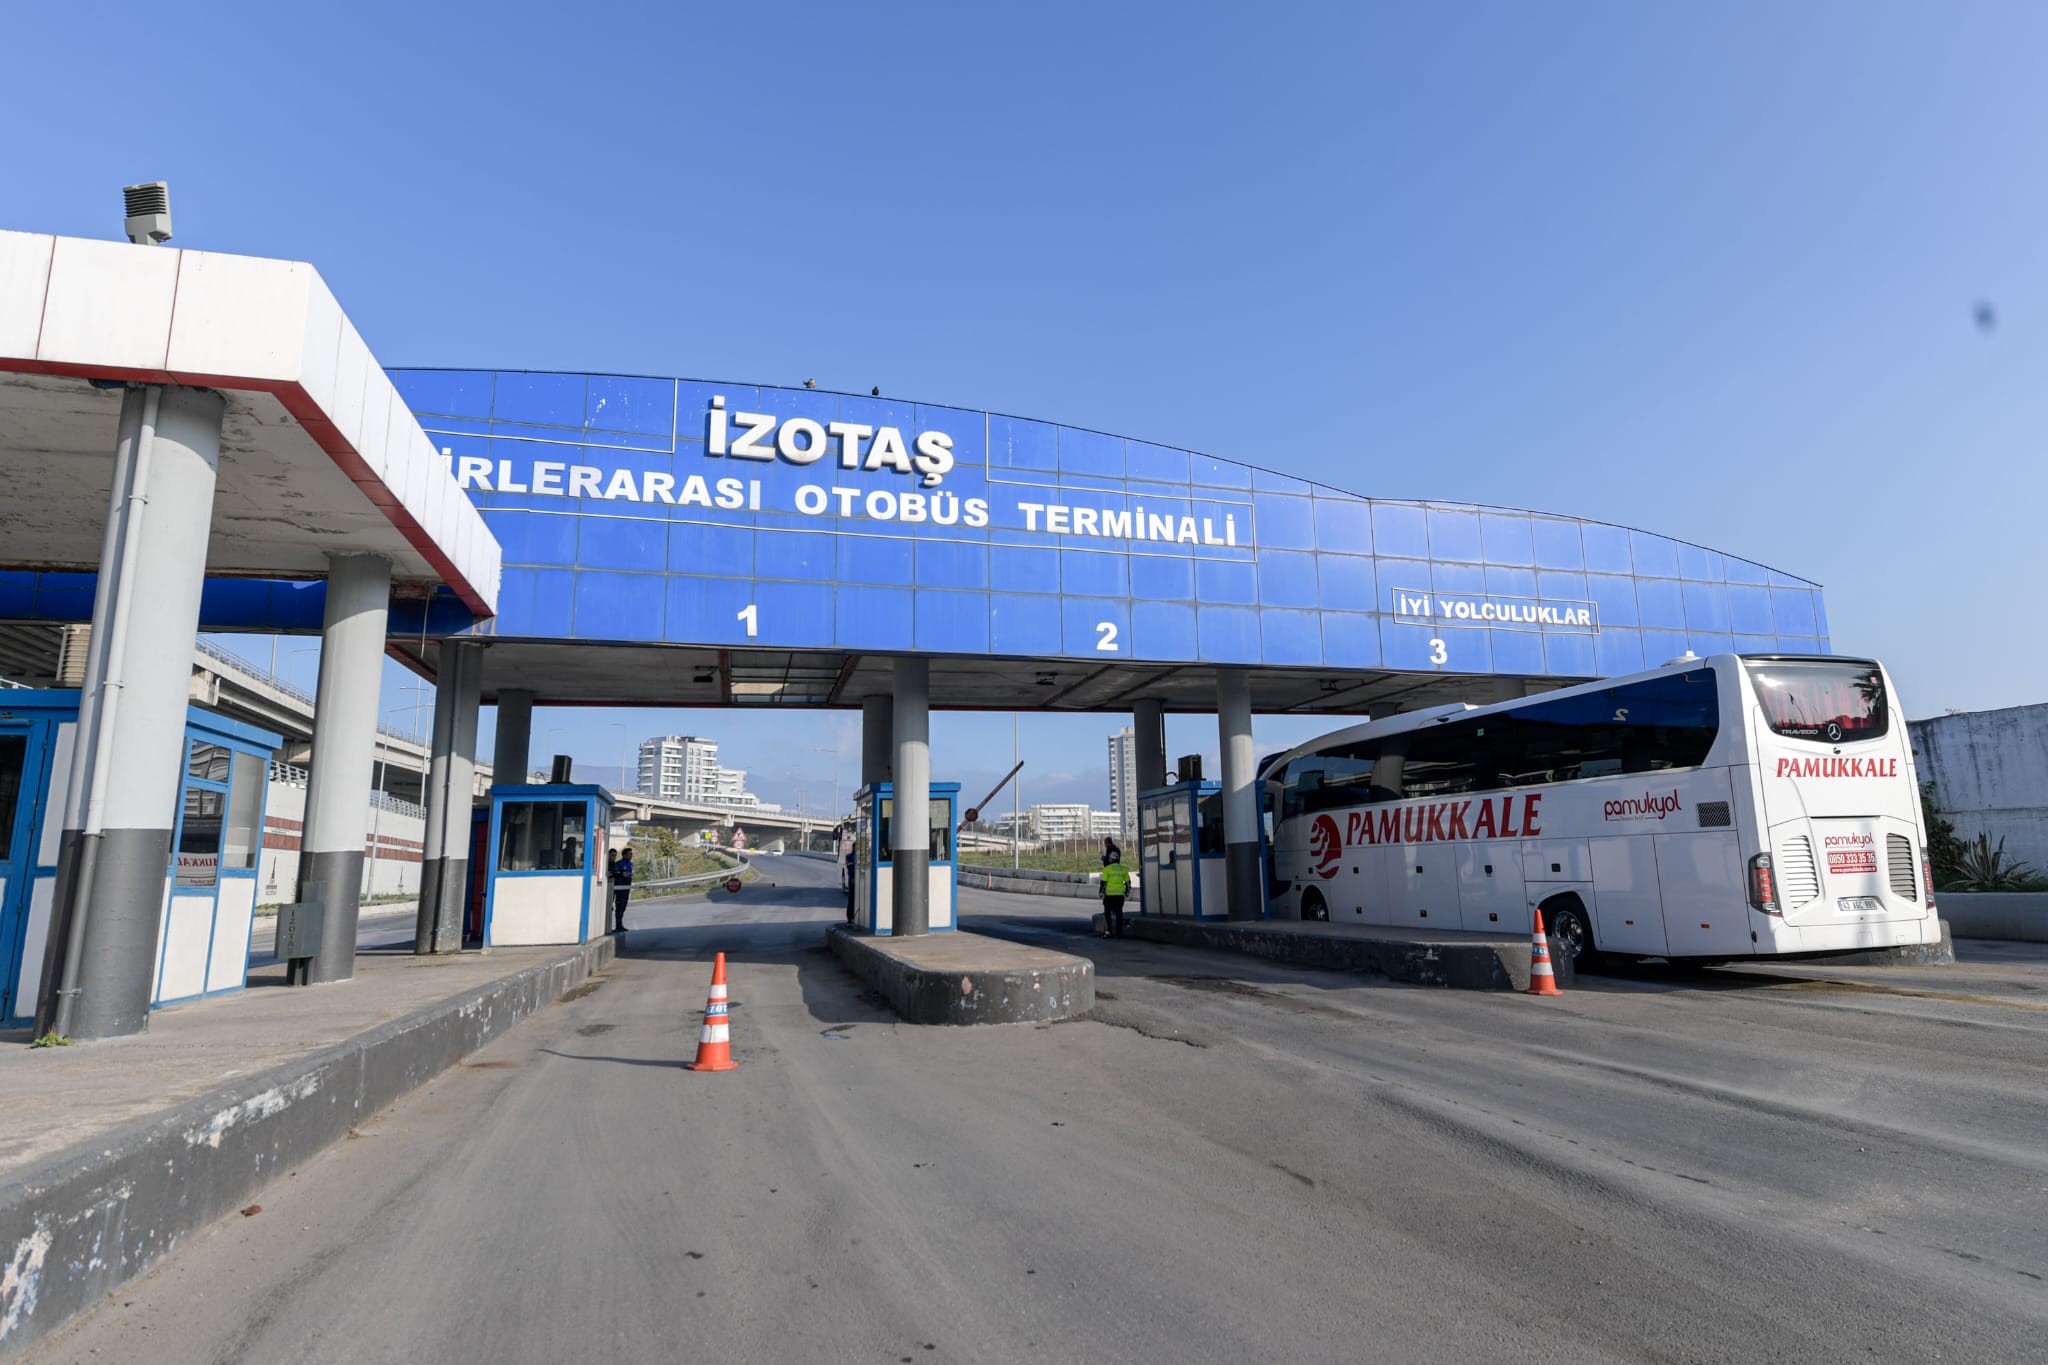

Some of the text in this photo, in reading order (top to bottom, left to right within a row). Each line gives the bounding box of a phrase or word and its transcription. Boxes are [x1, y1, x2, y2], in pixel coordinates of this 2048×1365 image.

[707, 396, 955, 487] İZOTAŞ
[795, 484, 989, 528] OTOBÜS
[1018, 502, 1237, 547] TERMİNALİ
[737, 605, 757, 637] 1
[1401, 594, 1592, 625] İYİ YOLCULUKLAR
[1096, 622, 1118, 651] 2
[1429, 638, 1448, 664] 3
[1776, 758, 1897, 778] PAMUKKALE
[1346, 793, 1542, 846] PAMUKKALE
[1604, 788, 1682, 821] pamukyol
[1825, 831, 1874, 848] pamukyol
